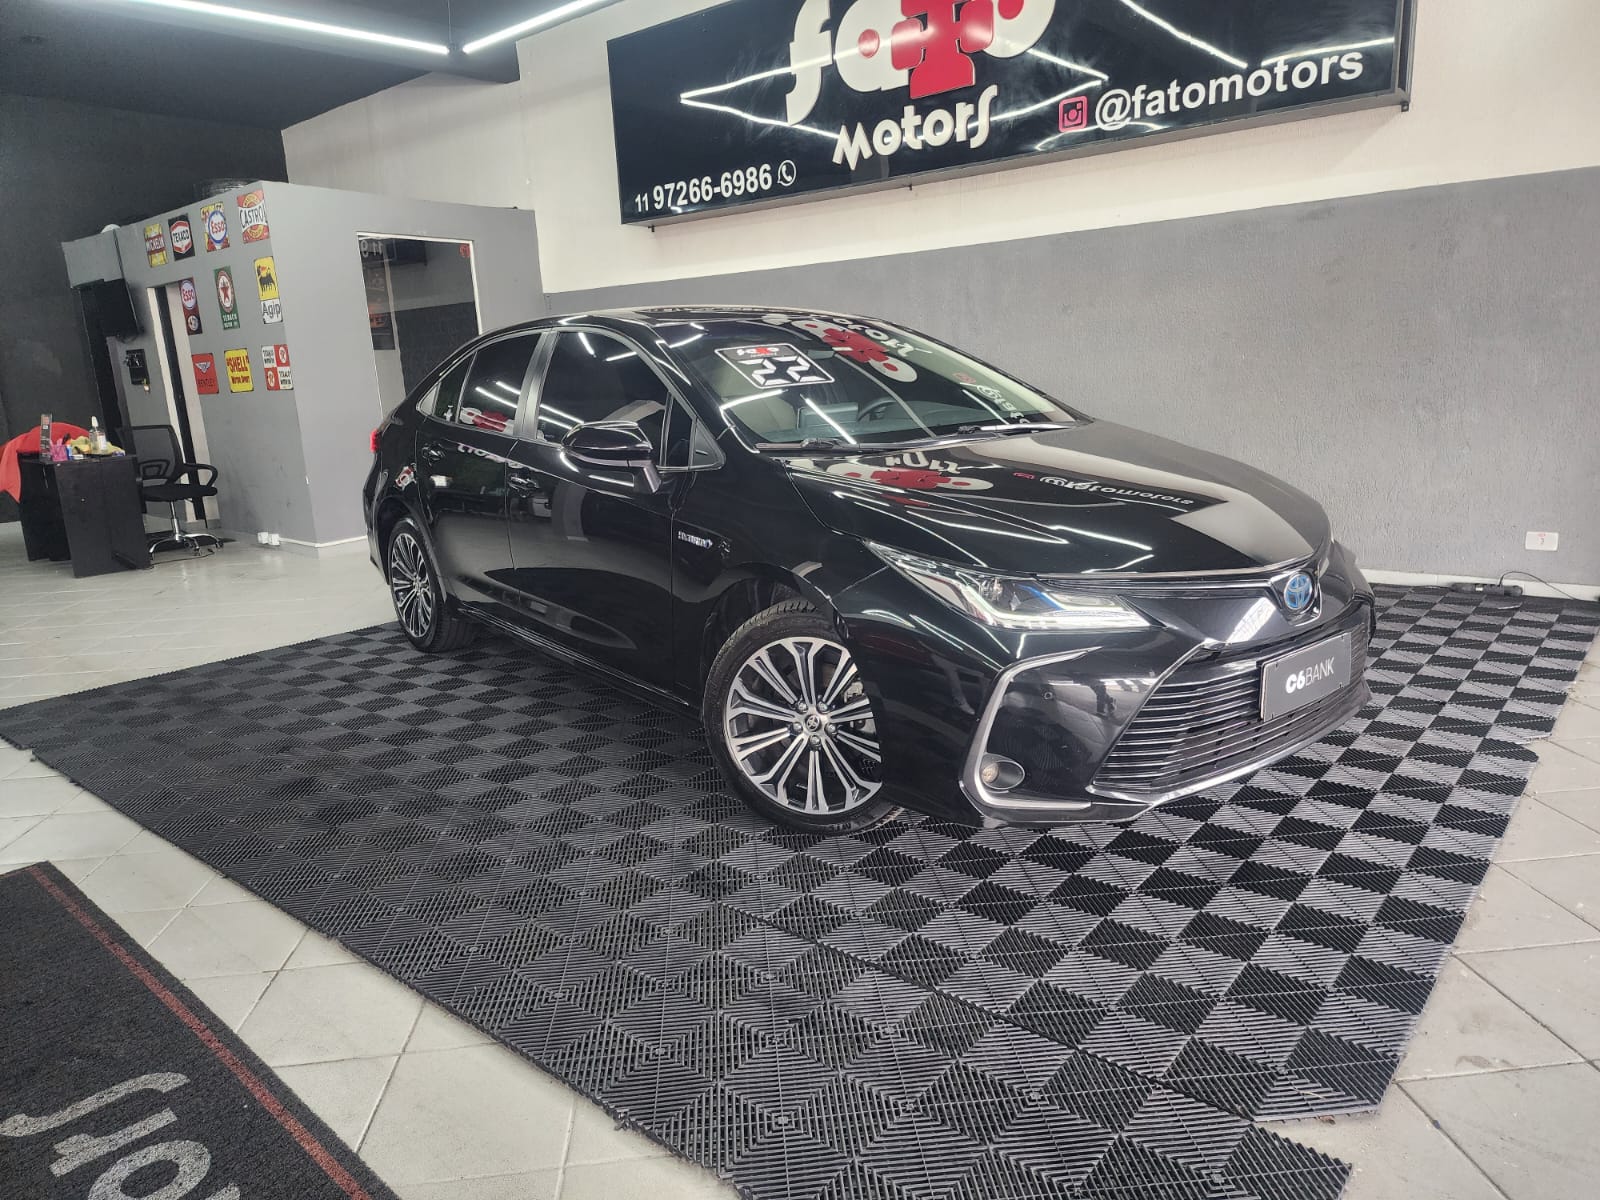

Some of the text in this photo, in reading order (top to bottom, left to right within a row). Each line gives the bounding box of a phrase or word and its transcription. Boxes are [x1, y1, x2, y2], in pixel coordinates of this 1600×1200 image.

[1095, 51, 1364, 131] @fatomotors
[635, 164, 773, 213] 11 97266-6986
[240, 204, 268, 228] CASTROL
[173, 229, 190, 243] TEXACO
[262, 301, 281, 319] Agip
